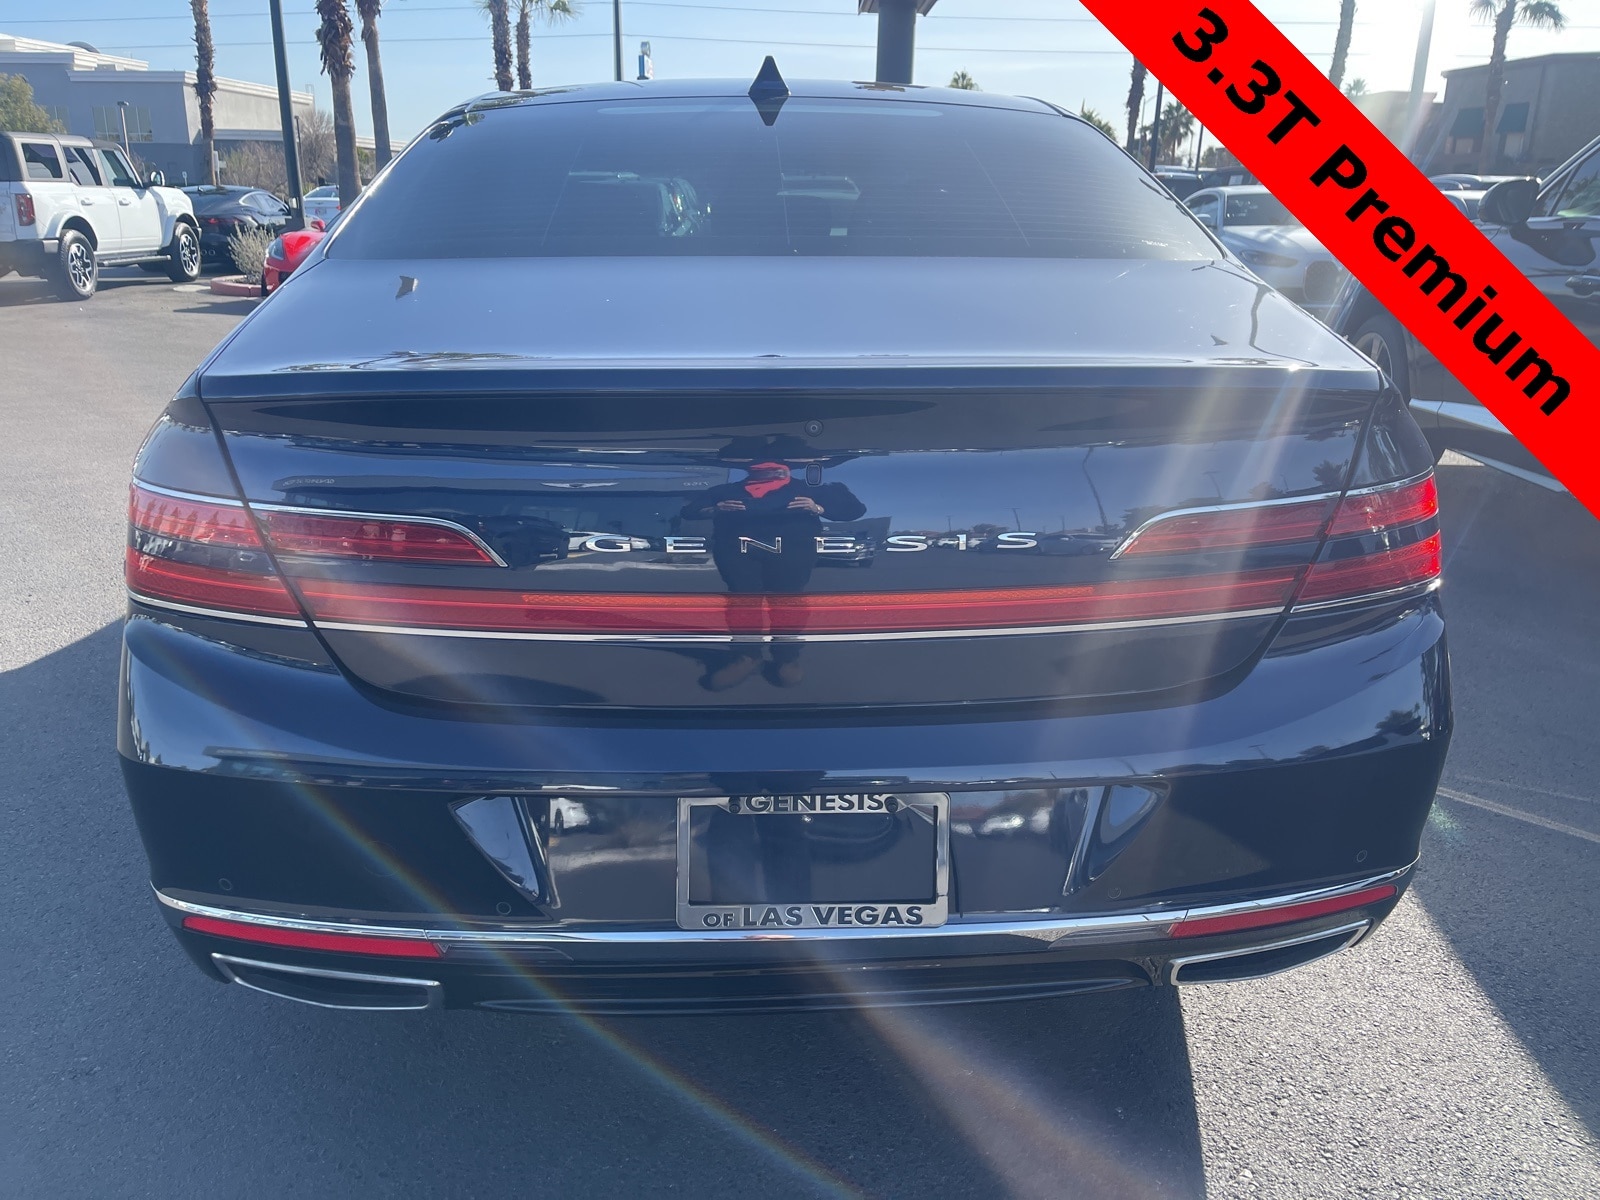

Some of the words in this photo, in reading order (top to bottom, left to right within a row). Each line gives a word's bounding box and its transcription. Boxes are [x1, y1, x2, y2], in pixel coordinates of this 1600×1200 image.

[585, 532, 1038, 554] GENESIS
[745, 794, 884, 812] GENESIS
[702, 913, 734, 927] OF
[743, 907, 802, 926] LAS
[813, 906, 923, 926] VEGAS
